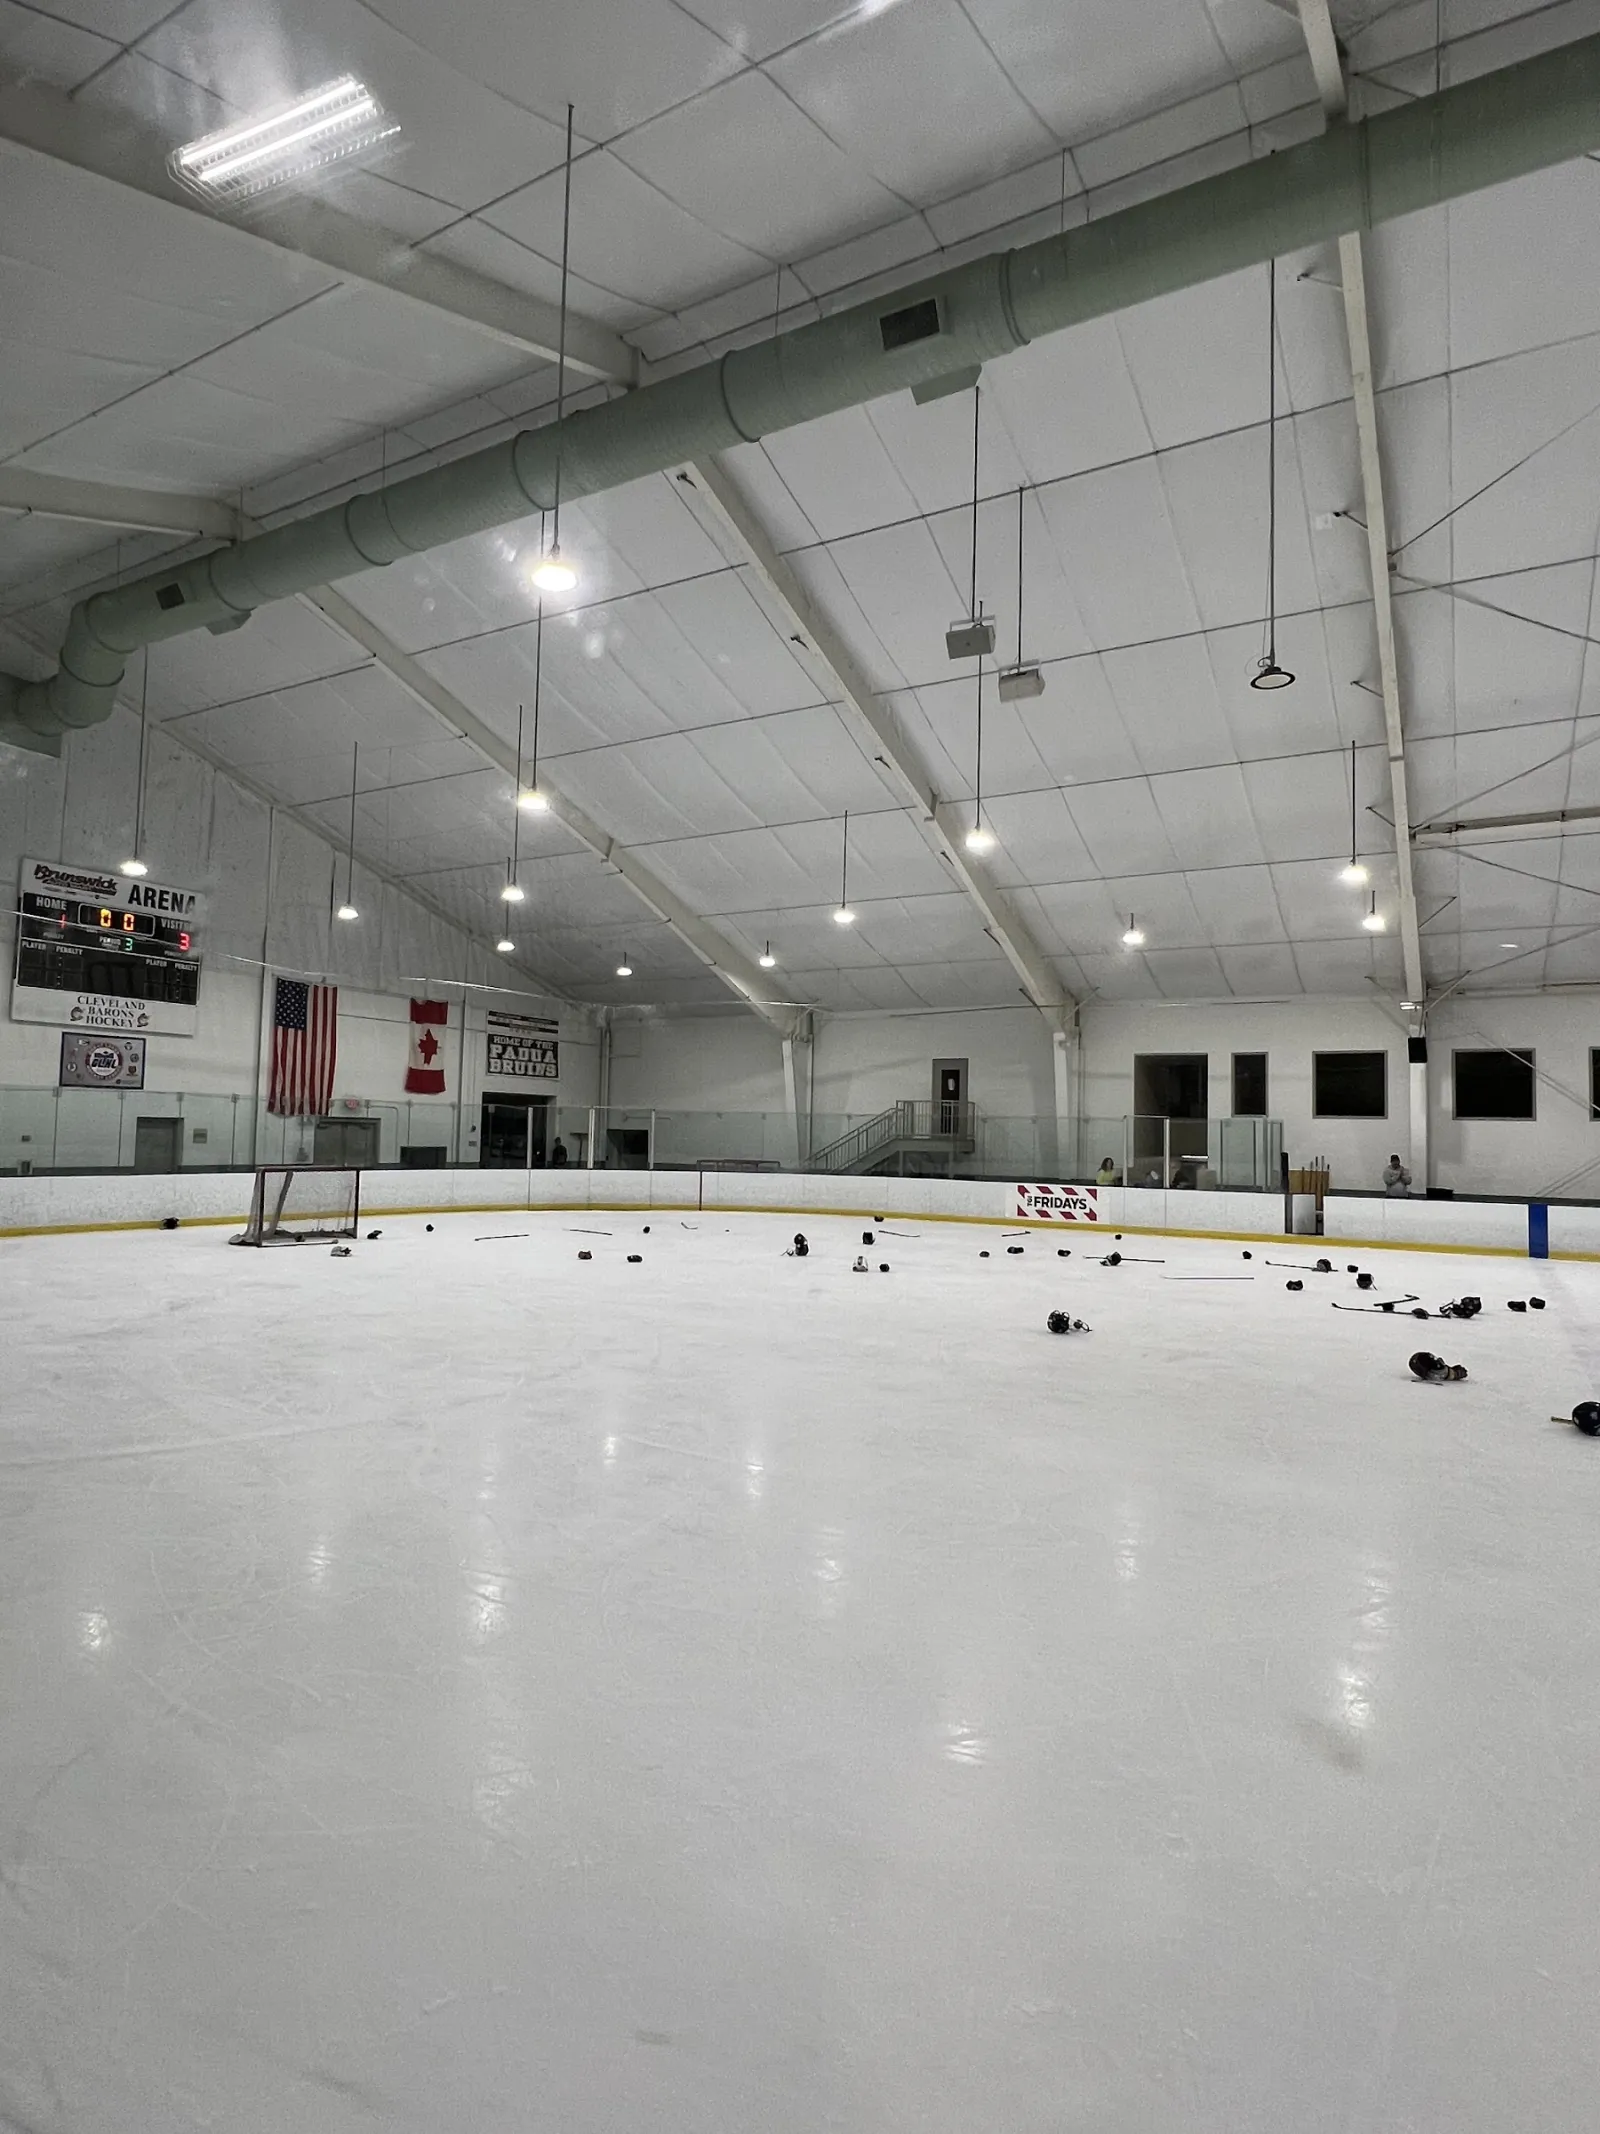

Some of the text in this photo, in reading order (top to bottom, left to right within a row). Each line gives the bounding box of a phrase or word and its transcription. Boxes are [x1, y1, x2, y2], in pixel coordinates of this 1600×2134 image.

[34, 864, 118, 892] Brunswick
[128, 884, 195, 914] ARENA
[36, 896, 68, 910] HOME
[100, 908, 134, 931] 0 0
[124, 937, 133, 951] 3
[179, 932, 190, 950] 3
[77, 996, 145, 1010] CLEVELAND
[88, 1006, 135, 1018] BARONS
[86, 1015, 133, 1028] HOCKEY
[494, 1036, 520, 1045] HOME
[489, 1044, 557, 1063] PADUA
[489, 1059, 557, 1077] BRUINS
[1034, 1196, 1087, 1210] FRIDAYS
